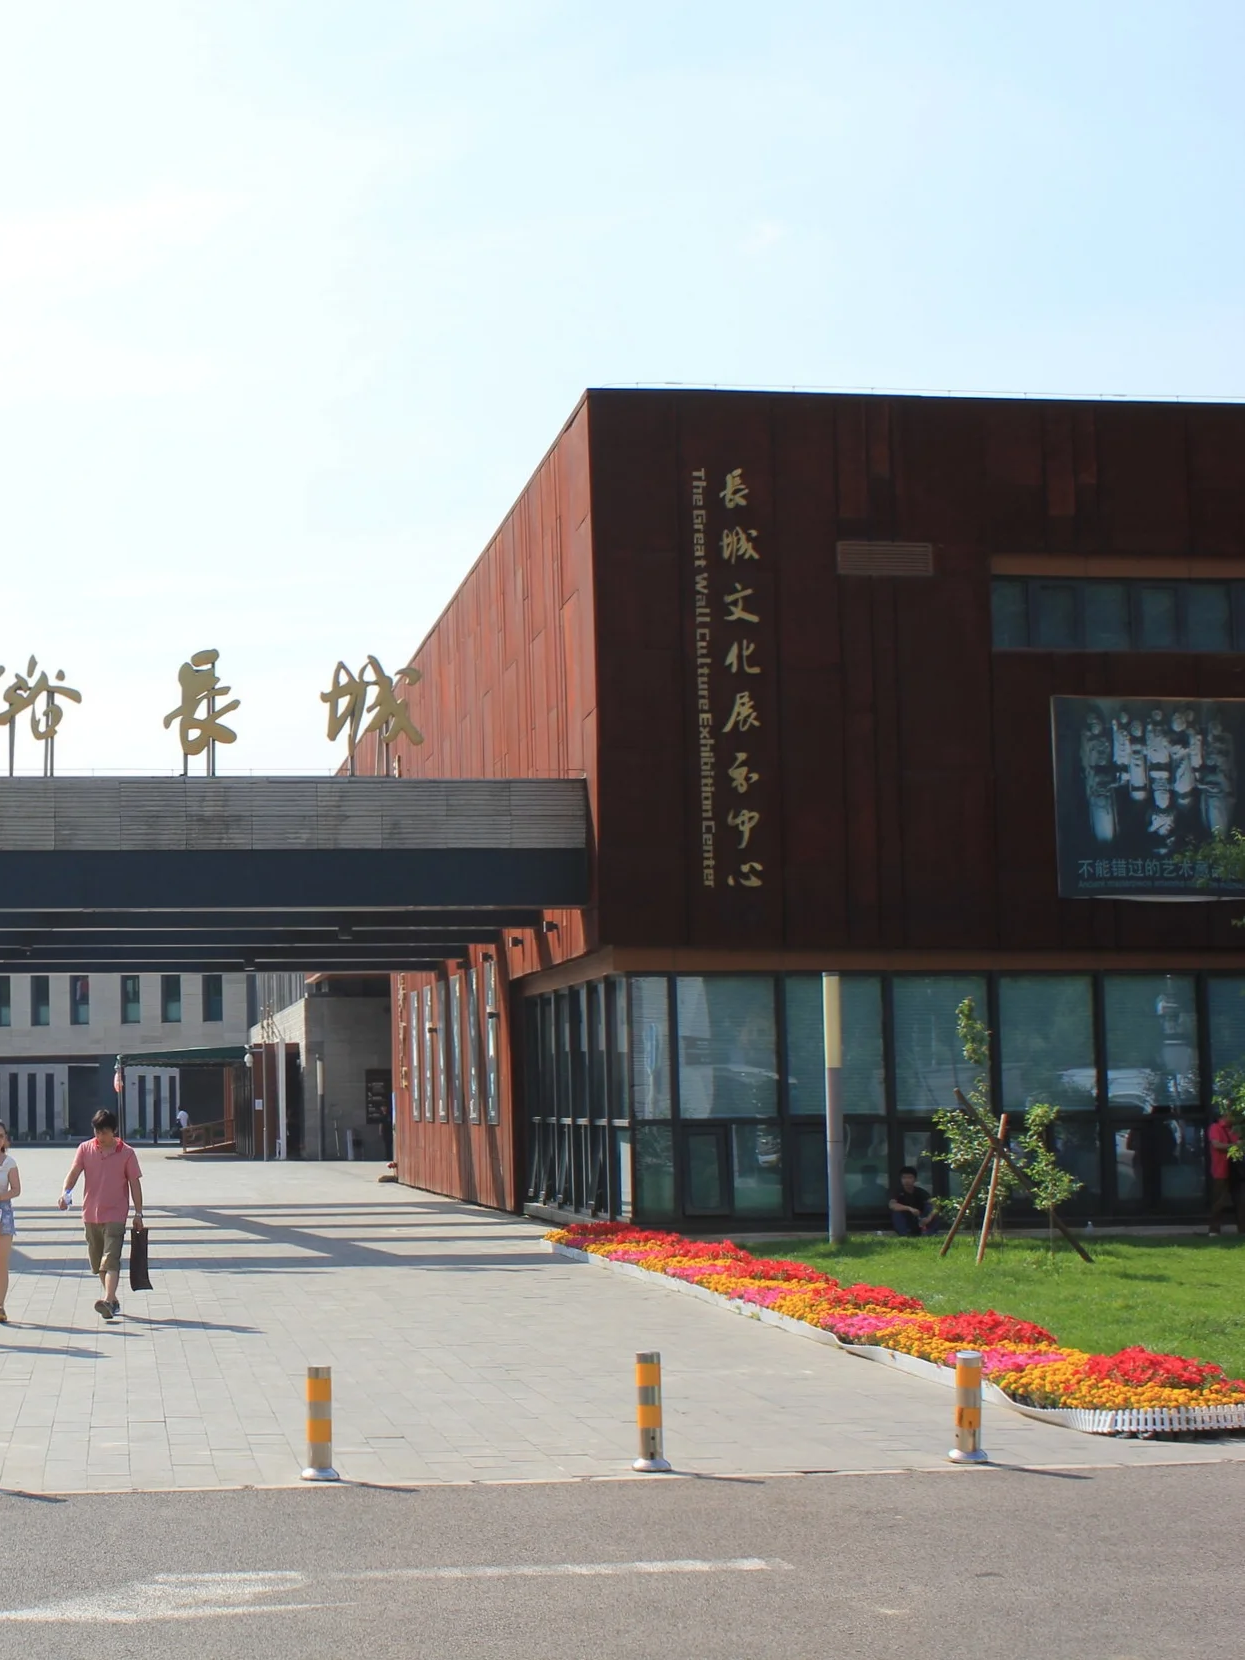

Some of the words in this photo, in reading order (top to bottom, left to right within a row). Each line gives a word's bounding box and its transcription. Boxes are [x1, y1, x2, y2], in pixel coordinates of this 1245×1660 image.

[691, 467, 707, 506] The
[692, 509, 708, 568] Great
[694, 572, 712, 624] Wall
[695, 627, 713, 710] Culture
[698, 712, 716, 818] Exhibition
[701, 820, 716, 888] Center
